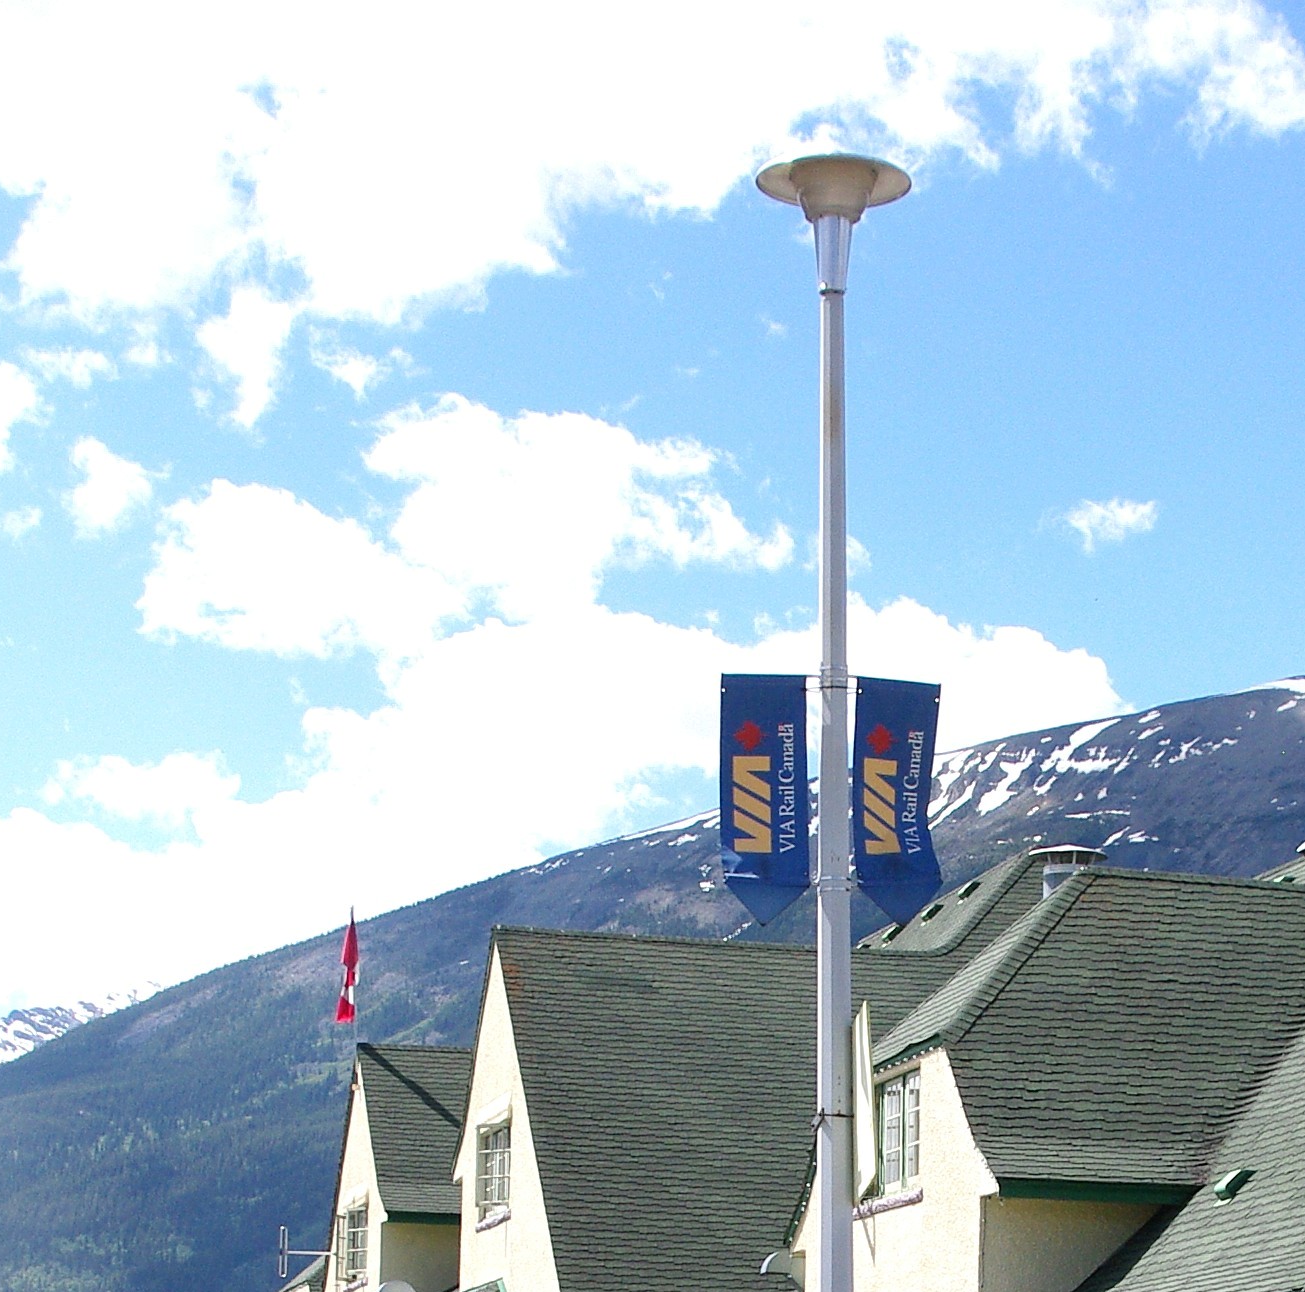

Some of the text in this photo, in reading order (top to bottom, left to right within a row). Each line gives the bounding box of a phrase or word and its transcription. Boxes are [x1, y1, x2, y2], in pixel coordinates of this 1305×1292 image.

[733, 755, 771, 853] VIA
[778, 723, 795, 853] VIA Rail Canada
[863, 757, 902, 855] VIA
[901, 731, 924, 854] VIA Rail Canada
